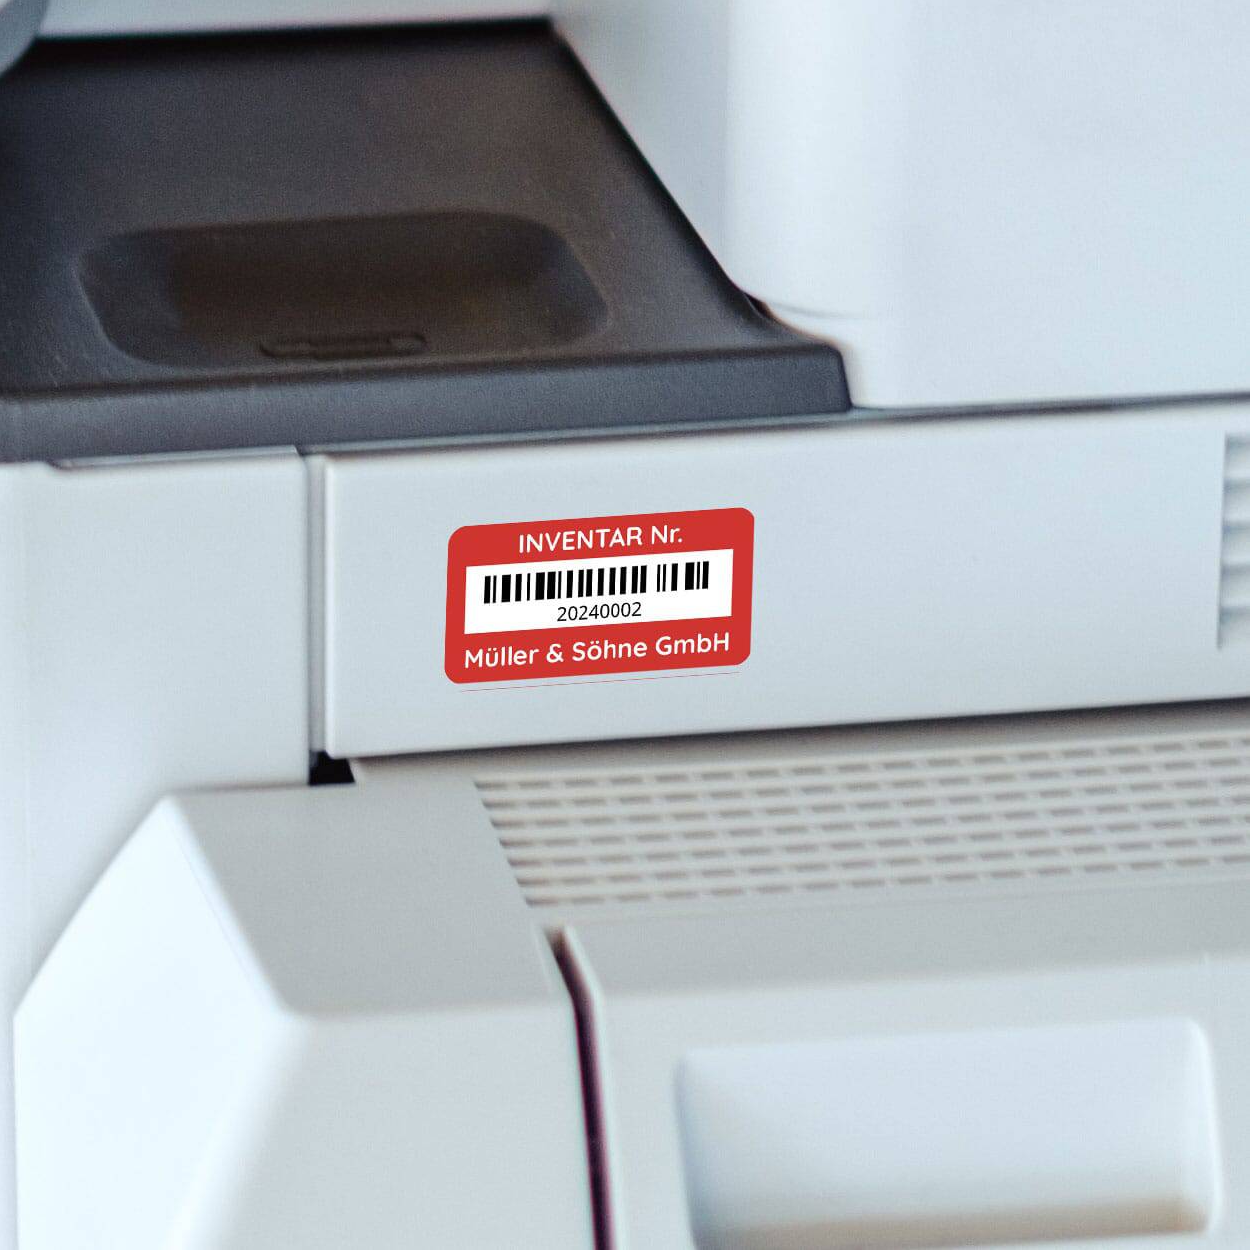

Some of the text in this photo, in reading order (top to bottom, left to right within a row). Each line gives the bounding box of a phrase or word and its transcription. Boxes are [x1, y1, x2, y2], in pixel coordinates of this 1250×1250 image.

[518, 524, 683, 554] INVENTAR Nr.
[556, 601, 642, 622] 20240002
[464, 631, 730, 669] Müller & Söhne GmbH
